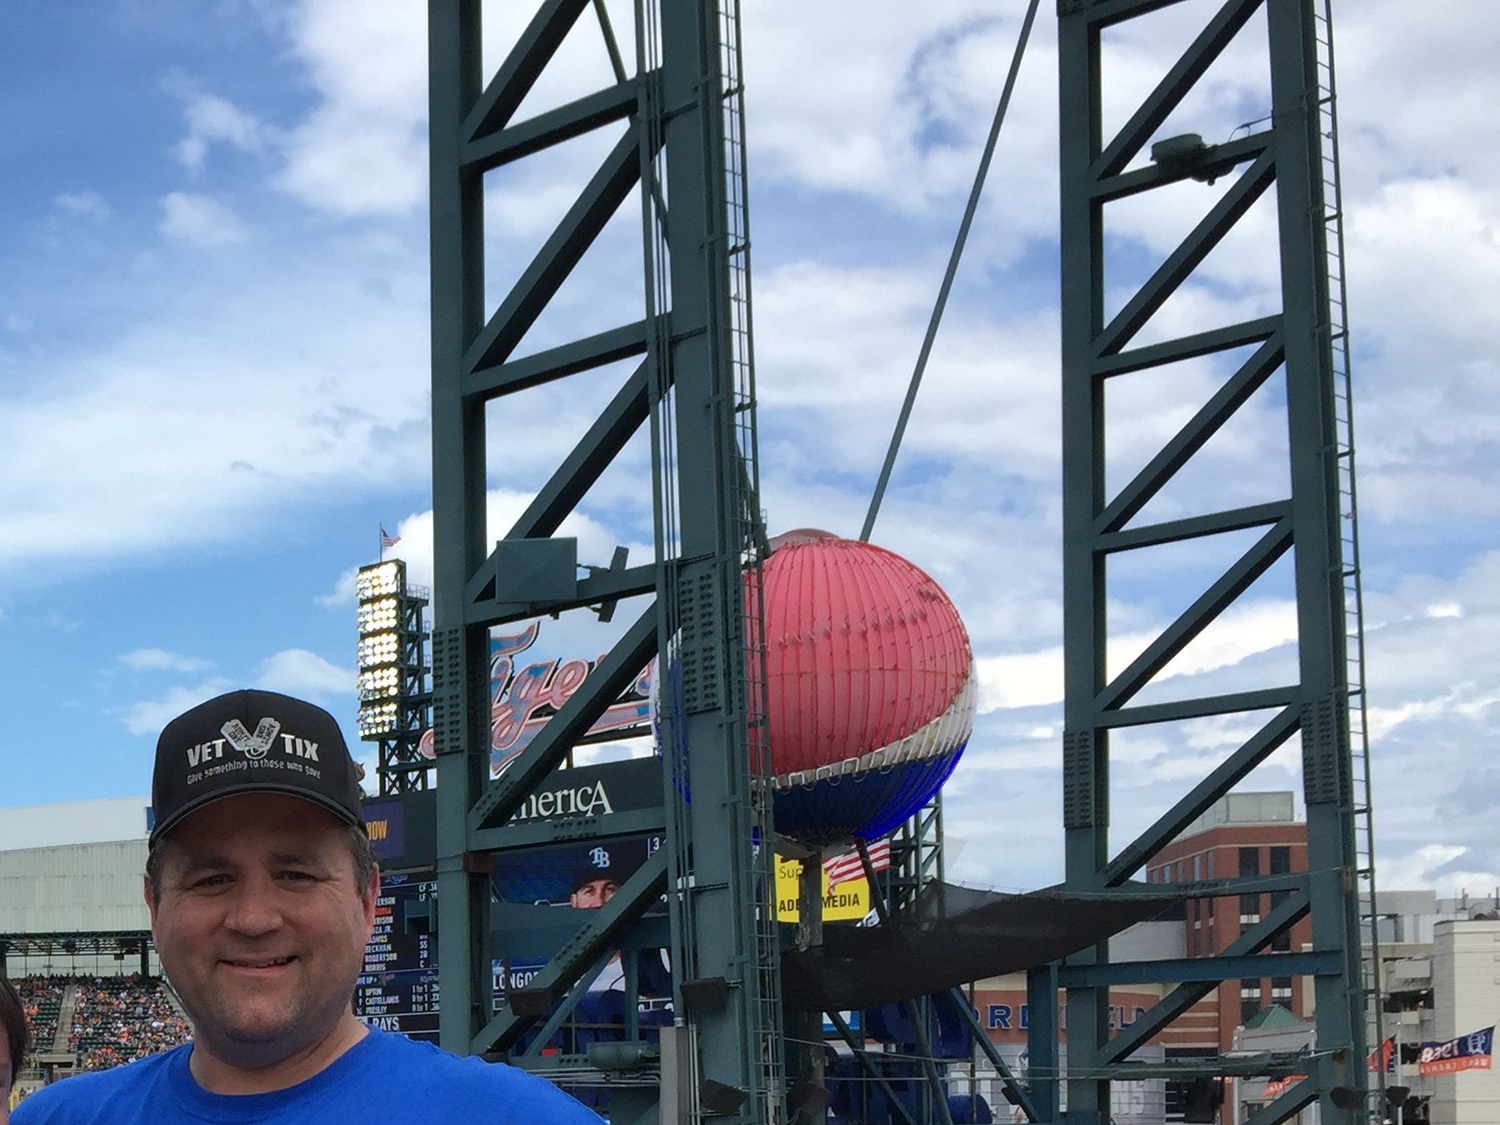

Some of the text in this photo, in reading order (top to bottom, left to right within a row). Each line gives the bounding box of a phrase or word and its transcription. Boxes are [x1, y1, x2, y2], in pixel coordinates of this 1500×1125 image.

[186, 733, 320, 768] VET TIX
[187, 772, 203, 785] Give
[204, 760, 248, 777] something
[249, 760, 259, 768] to
[260, 758, 284, 769] those
[287, 761, 302, 772] who
[492, 971, 540, 990] LONGO
